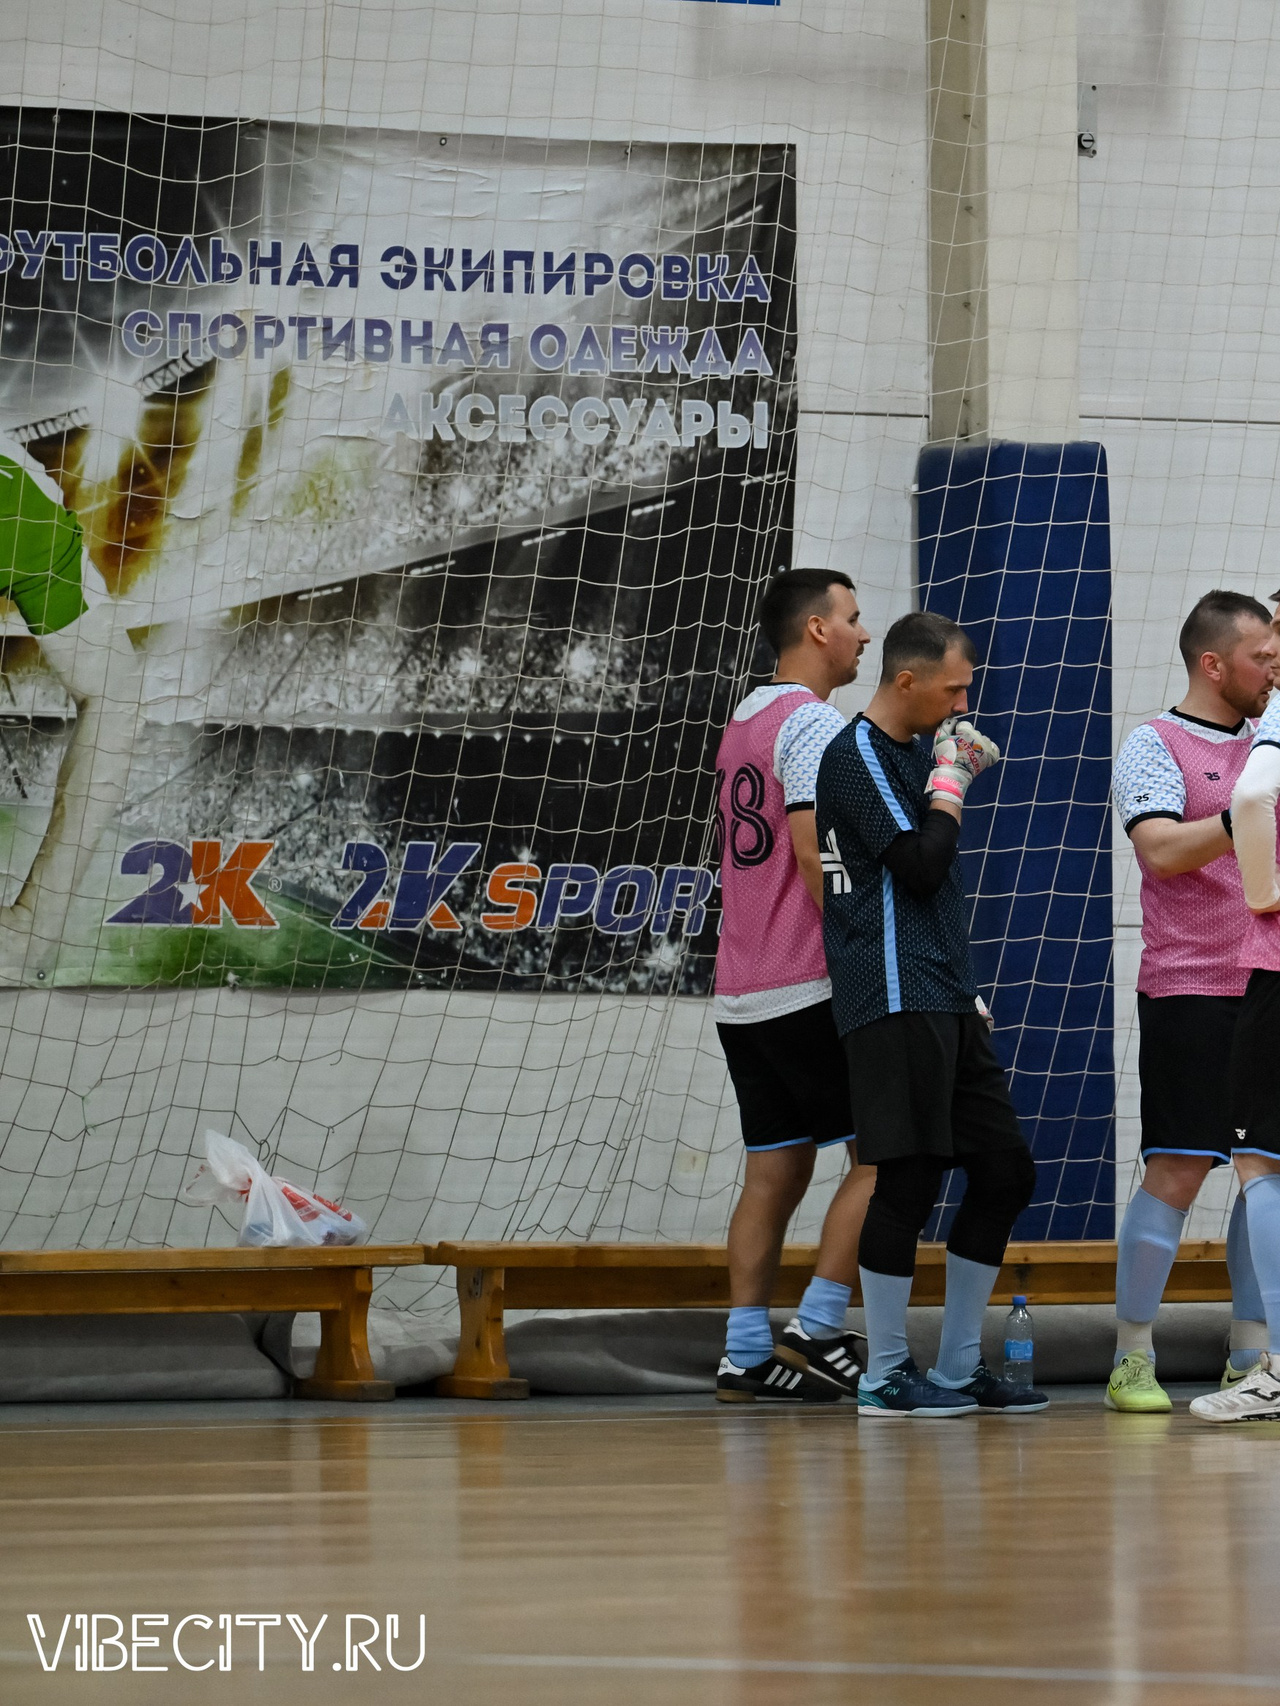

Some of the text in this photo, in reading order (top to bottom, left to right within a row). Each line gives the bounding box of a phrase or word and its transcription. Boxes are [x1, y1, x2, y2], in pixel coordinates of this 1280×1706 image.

[379, 245, 772, 303] ЭКИПИРОВКА
[121, 308, 773, 378] СПОРТИВНАЯ ОДЕЖДА
[382, 391, 770, 450] АКСЕССУАРЫ
[104, 838, 279, 930] 2K
[332, 840, 724, 937] 2K SPOR
